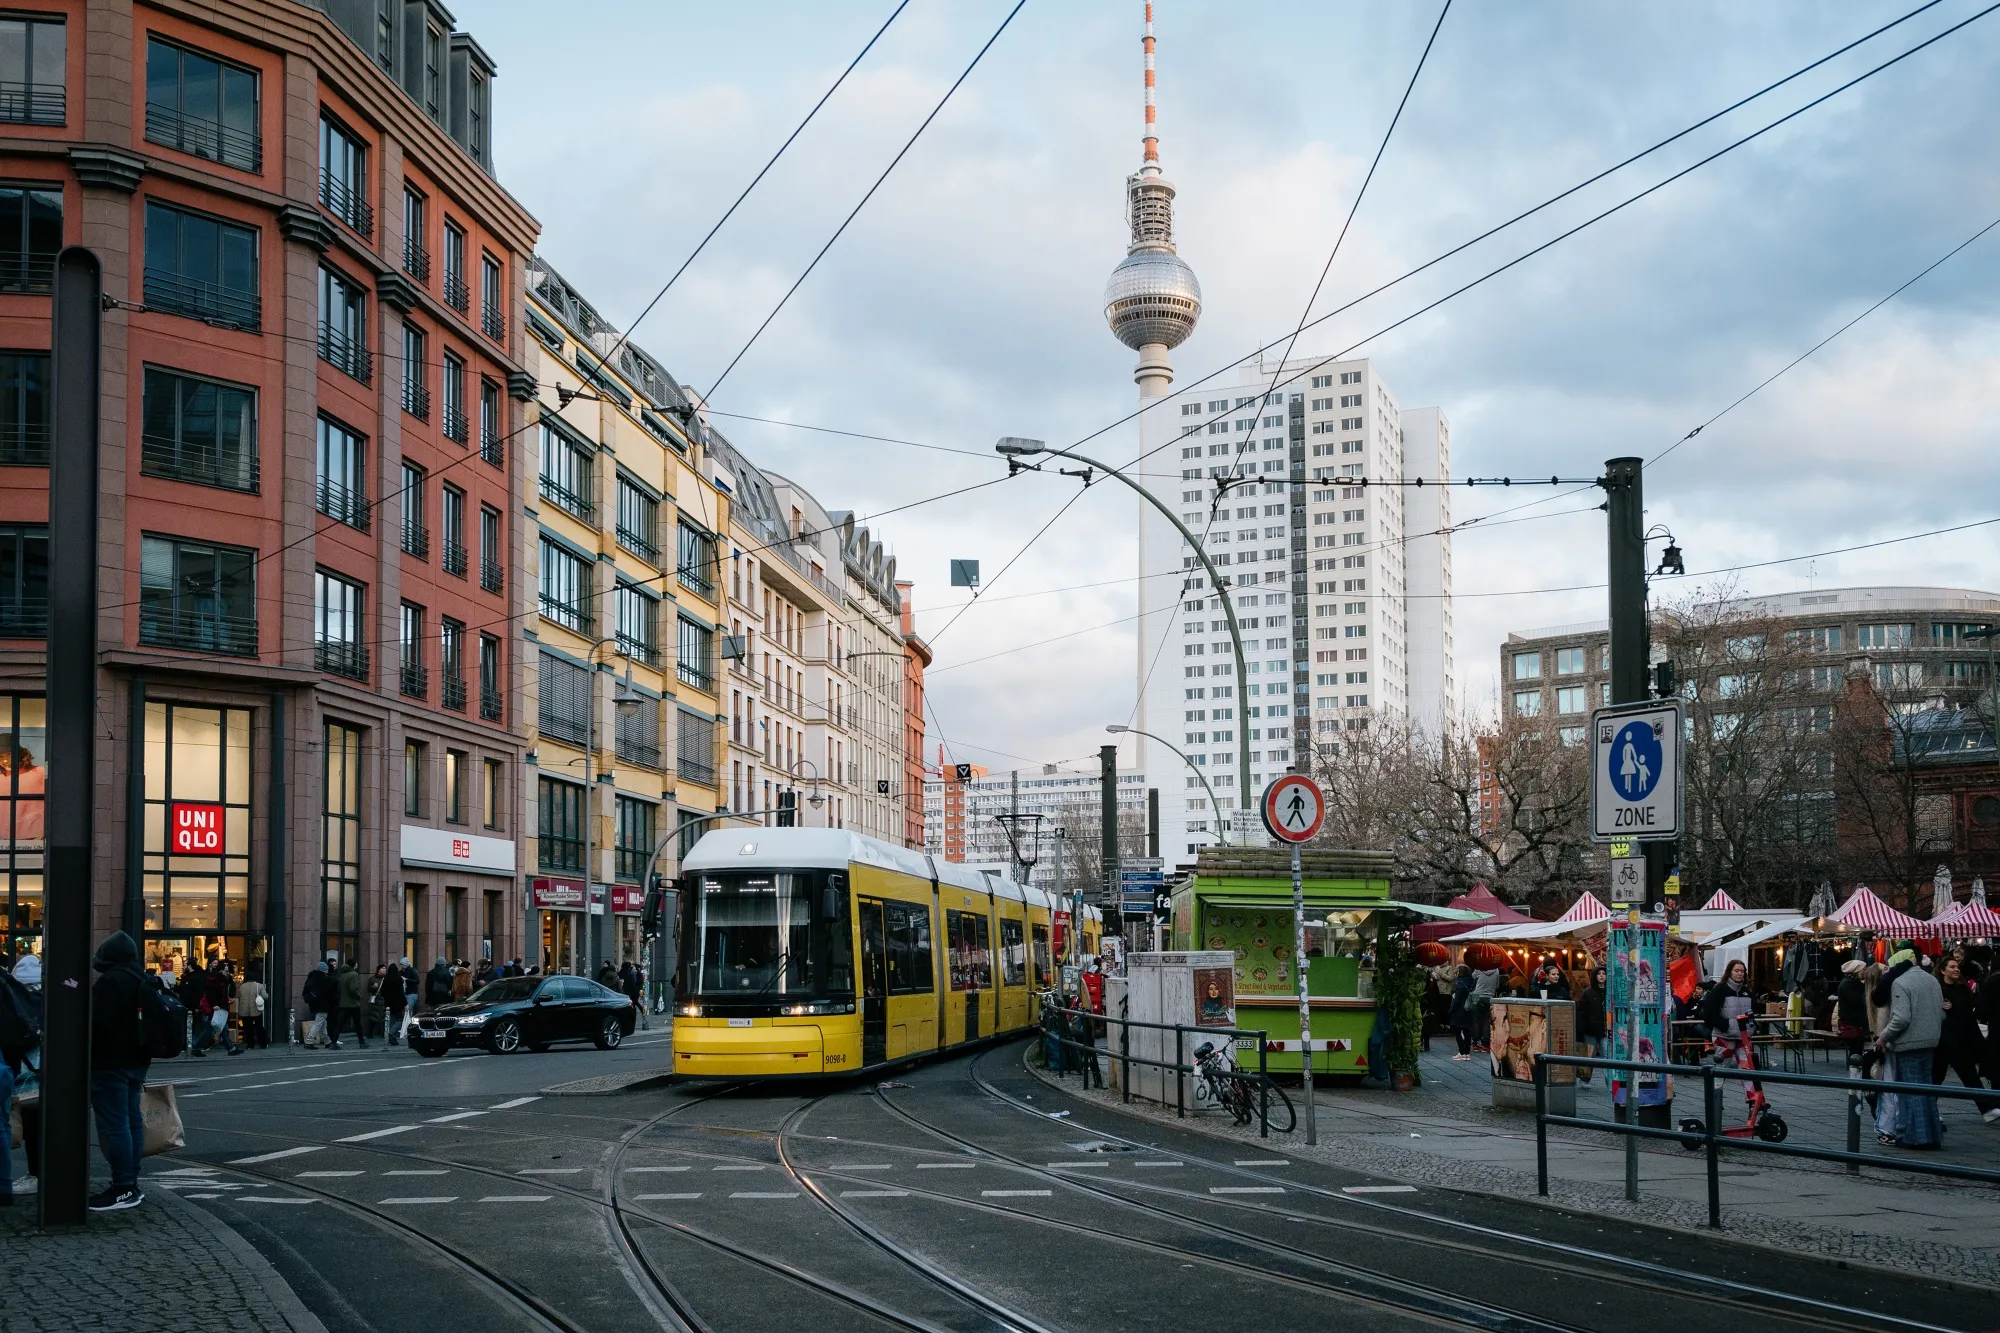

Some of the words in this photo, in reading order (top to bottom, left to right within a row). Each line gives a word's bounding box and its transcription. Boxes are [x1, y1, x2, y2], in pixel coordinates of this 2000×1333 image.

[179, 809, 215, 828] UNI
[1615, 806, 1655, 827] ZONE
[179, 830, 218, 850] QLO
[1613, 930, 1660, 946] UNTY
[1614, 1008, 1660, 1024] UNTY
[116, 1191, 132, 1202] FILA
